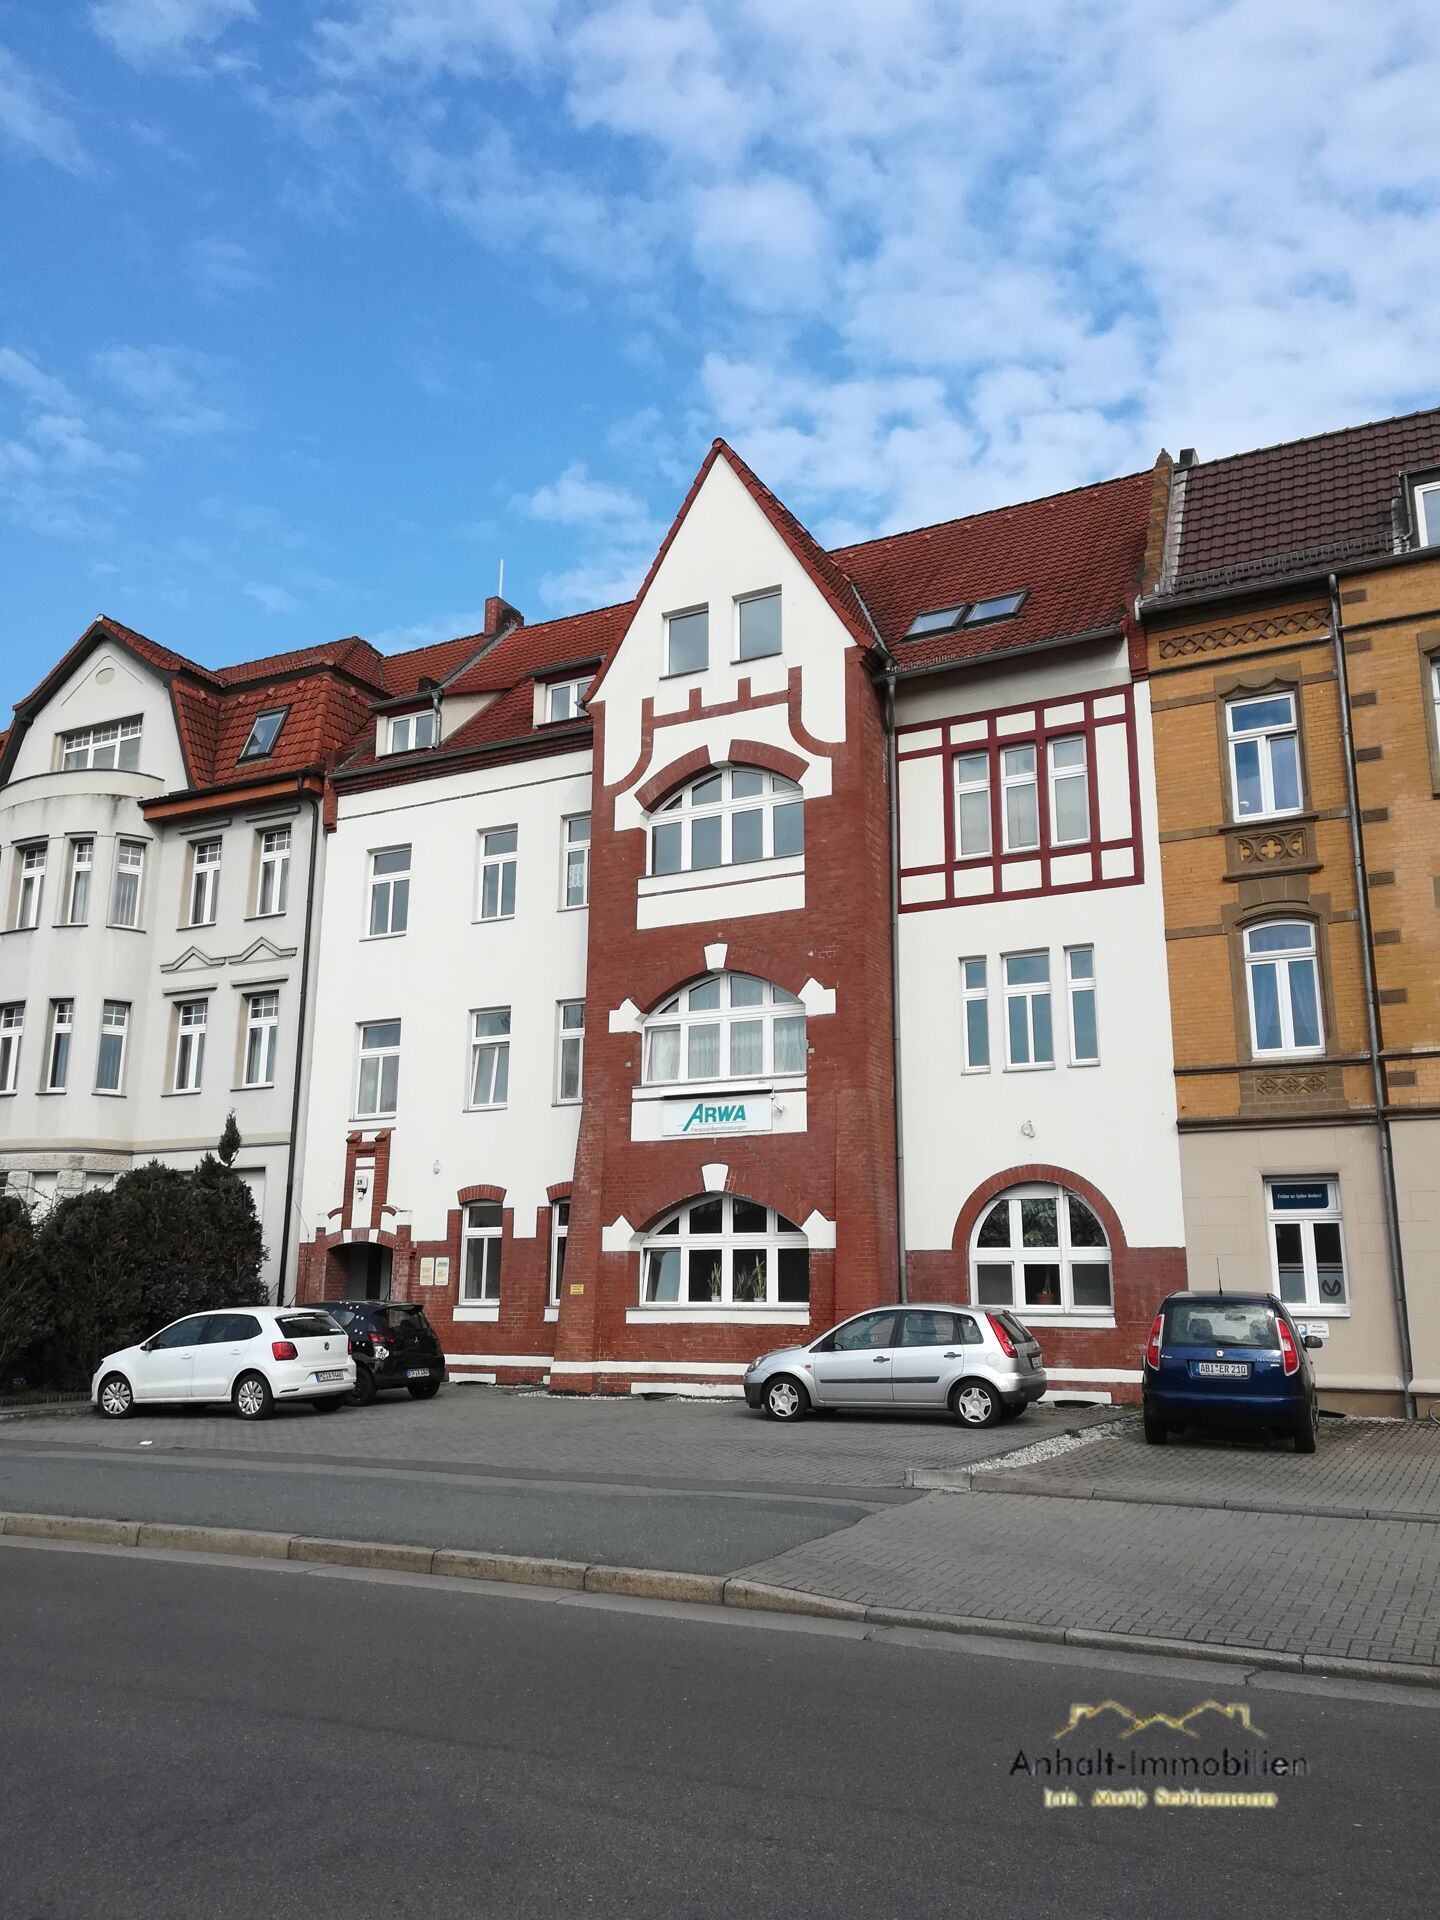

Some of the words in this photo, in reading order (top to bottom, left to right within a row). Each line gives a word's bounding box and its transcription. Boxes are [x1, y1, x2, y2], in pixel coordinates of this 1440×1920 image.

[682, 1103, 746, 1132] ARWA
[1200, 1363, 1214, 1374] ABI
[1219, 1364, 1230, 1374] ER
[1231, 1364, 1246, 1375] 210
